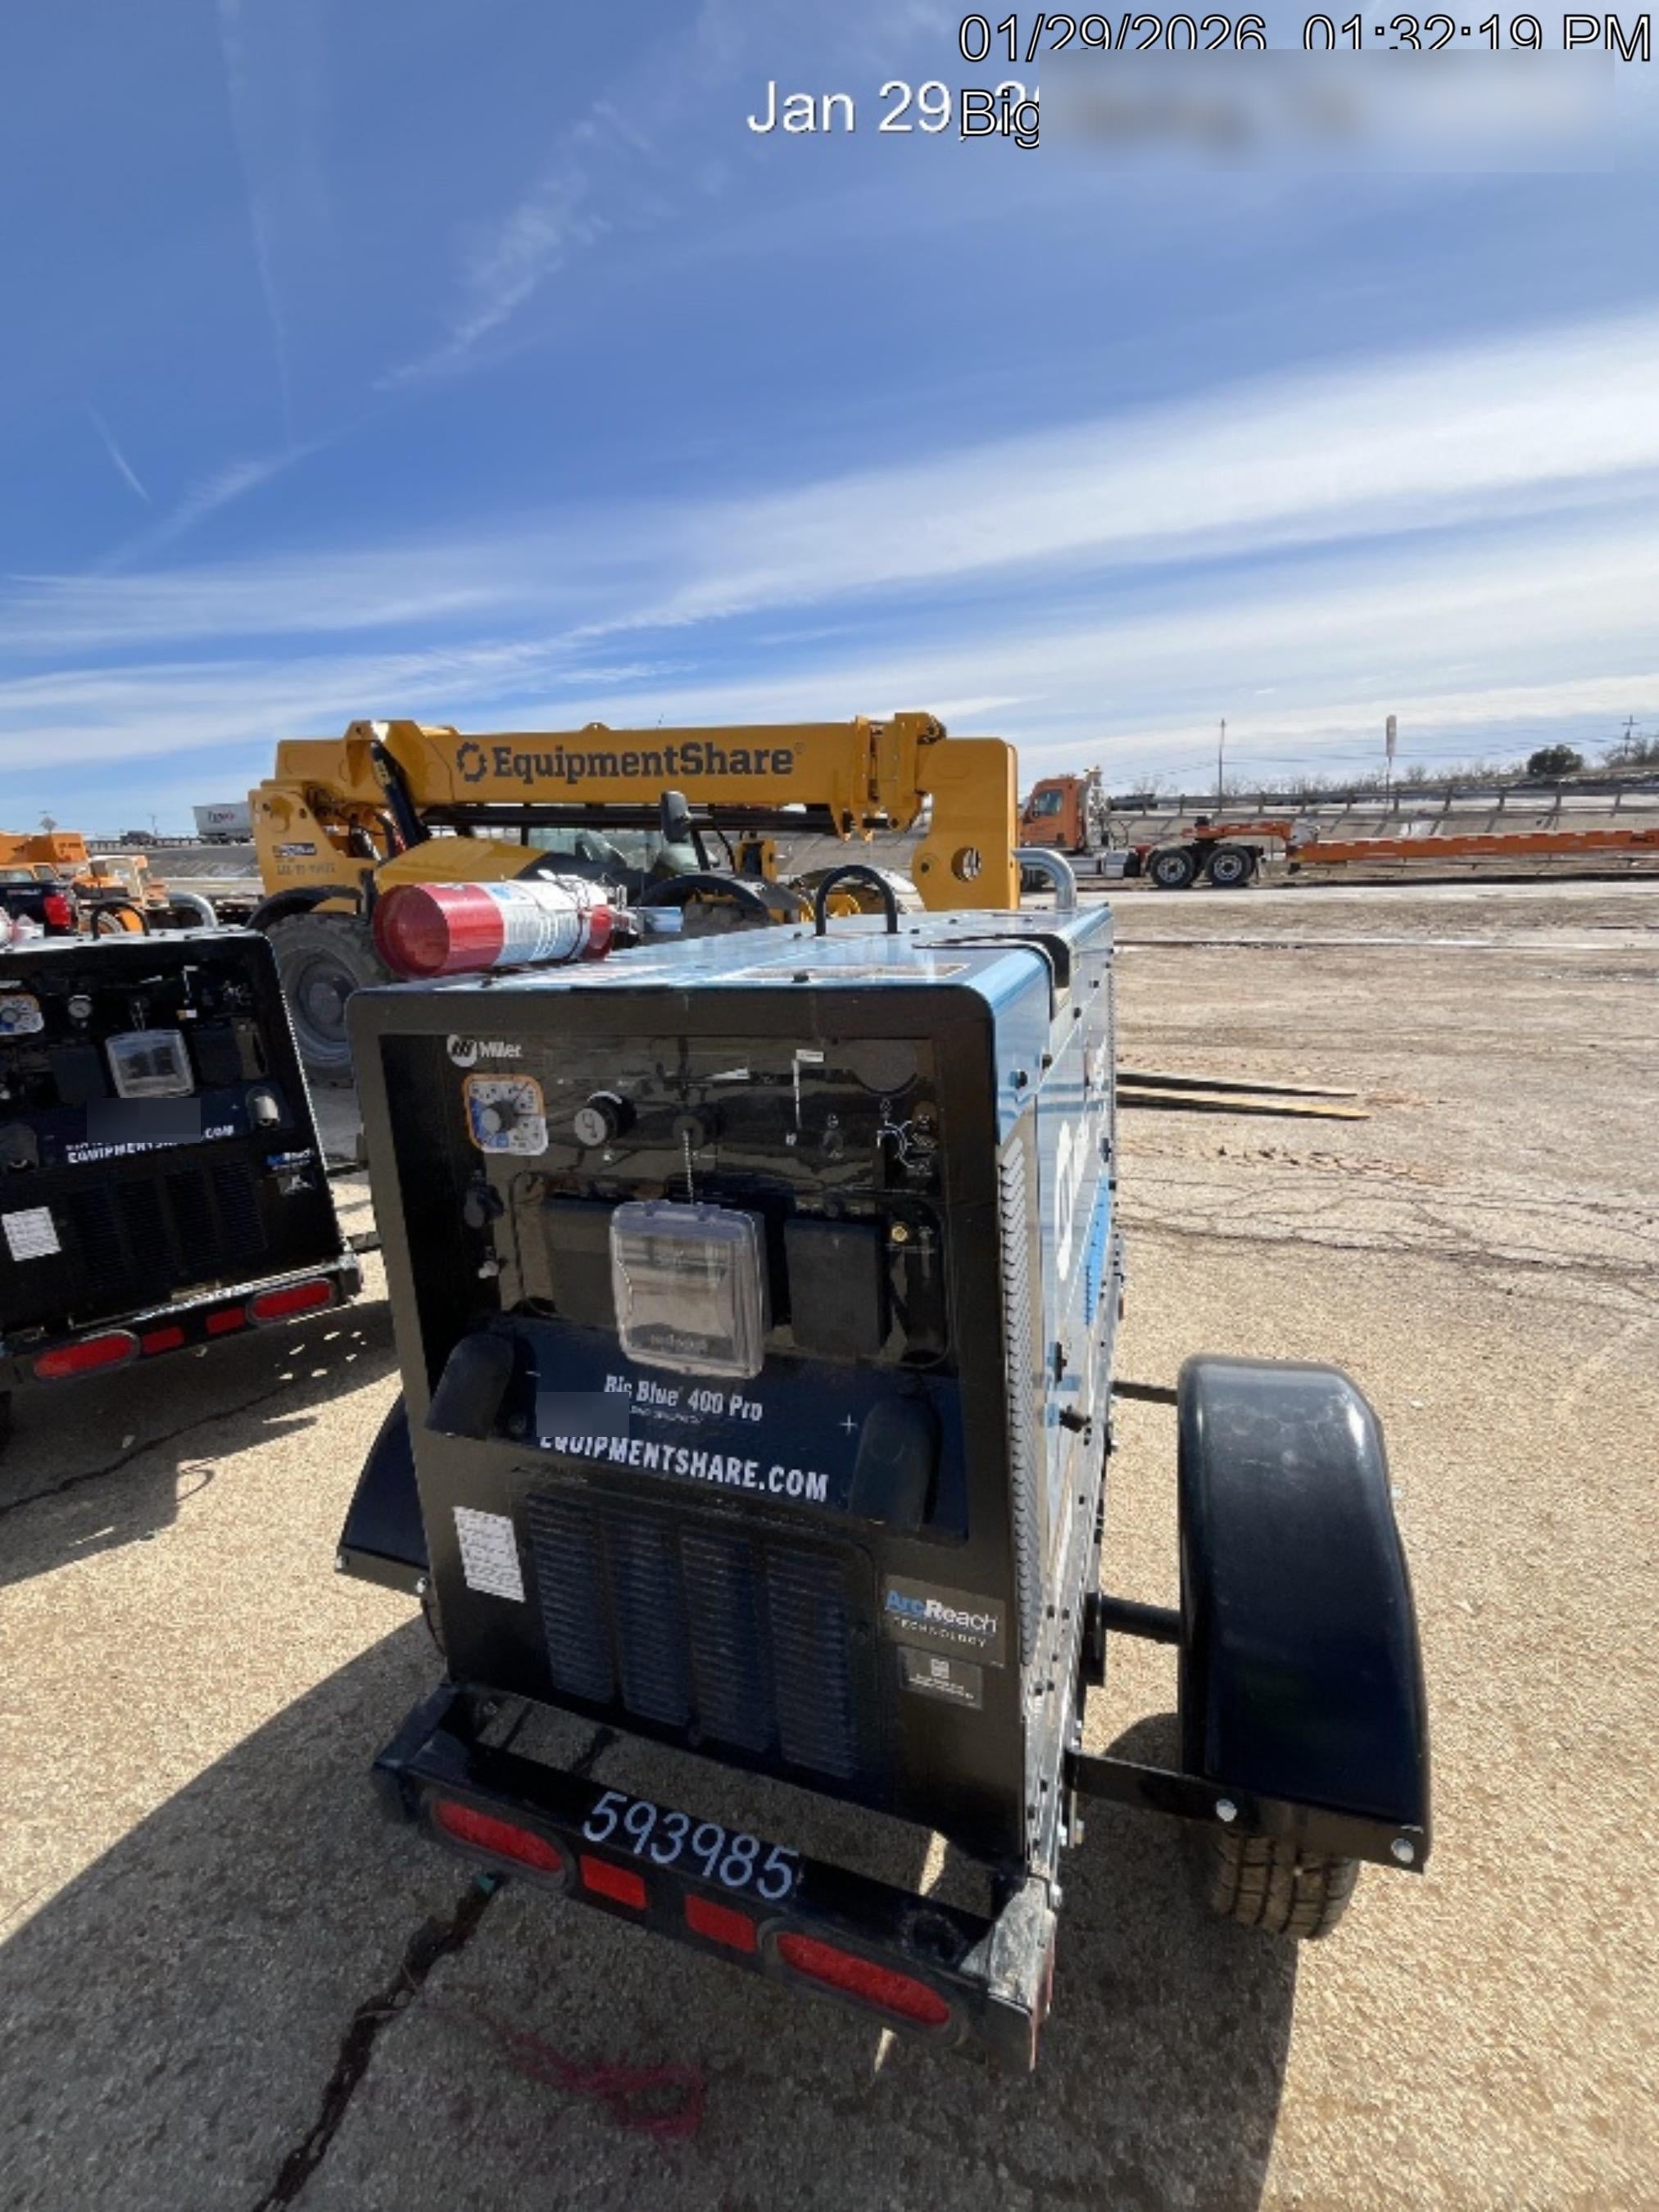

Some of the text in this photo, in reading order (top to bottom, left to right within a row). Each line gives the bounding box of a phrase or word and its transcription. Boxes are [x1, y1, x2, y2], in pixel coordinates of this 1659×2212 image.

[492, 741, 793, 785] EquipmentShare
[635, 1380, 679, 1407] Blue
[687, 1388, 724, 1415] 400
[728, 1394, 764, 1422] Pro
[885, 1589, 998, 1634] ArcReach
[582, 1791, 800, 1900] 593985
